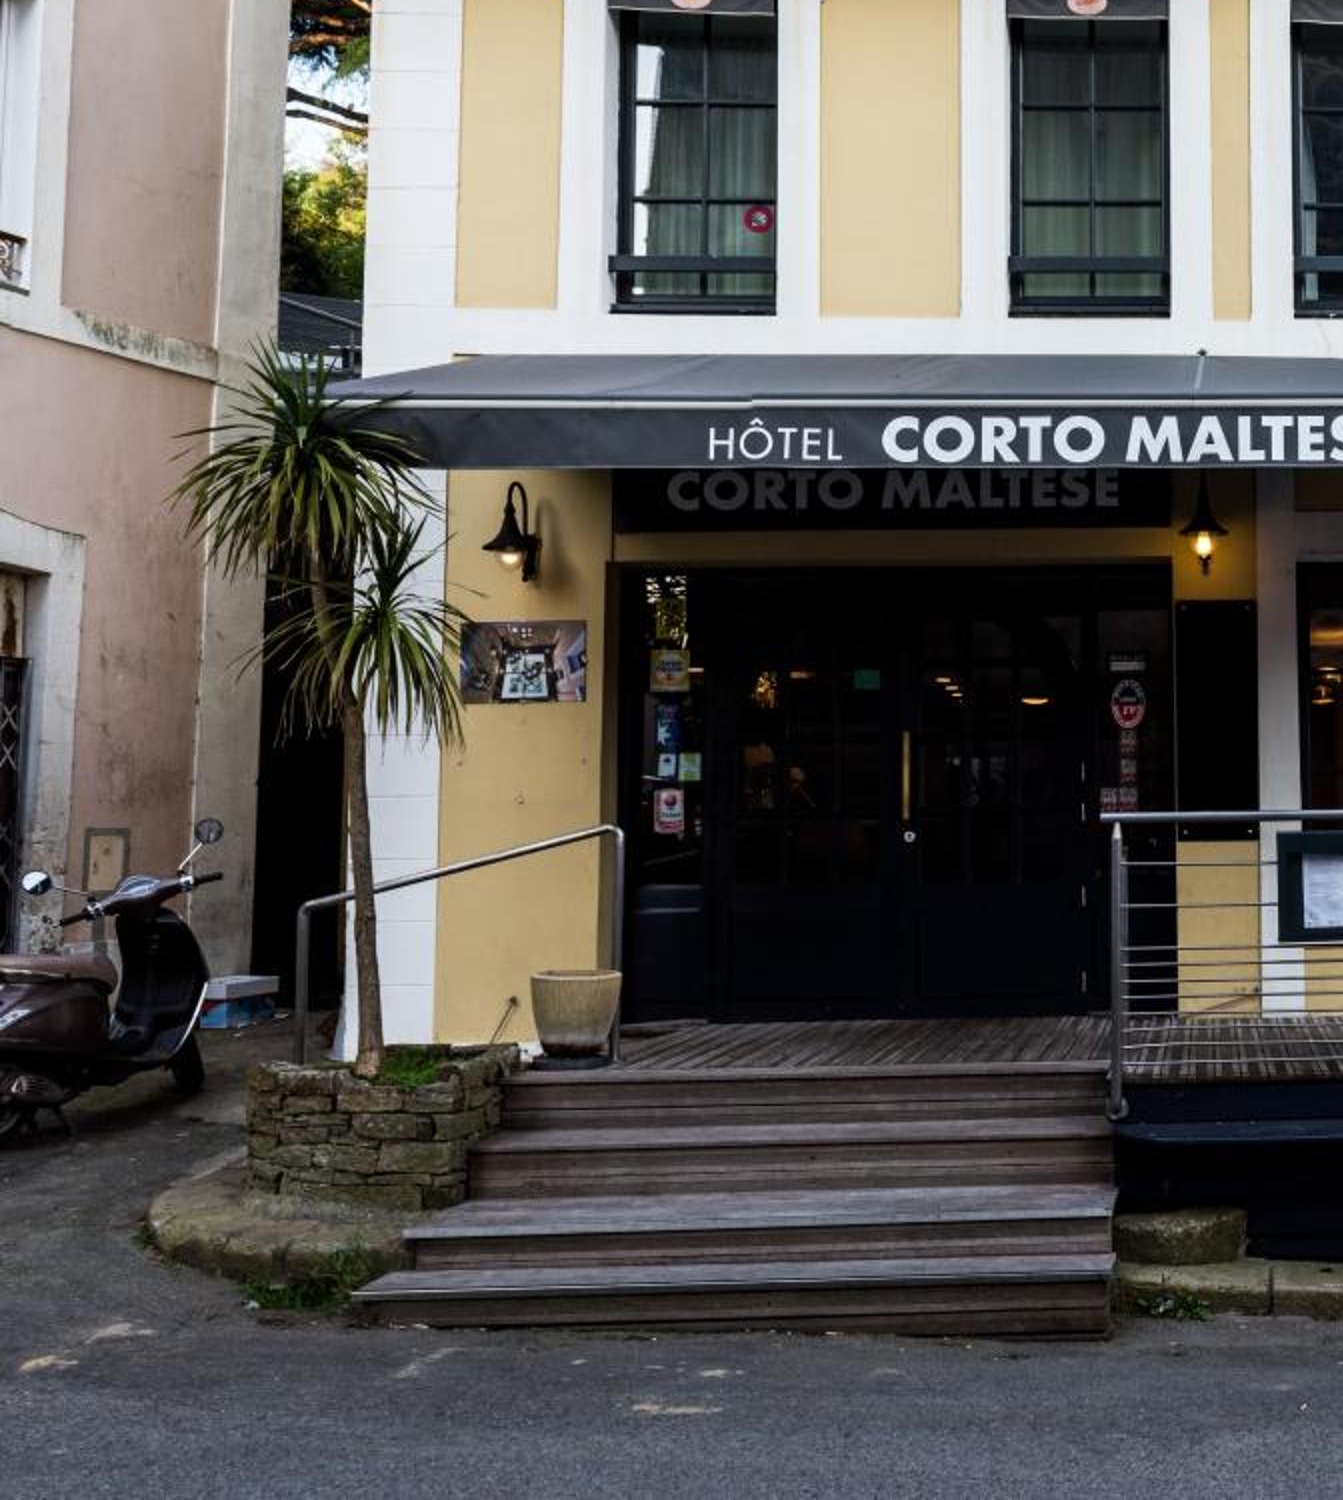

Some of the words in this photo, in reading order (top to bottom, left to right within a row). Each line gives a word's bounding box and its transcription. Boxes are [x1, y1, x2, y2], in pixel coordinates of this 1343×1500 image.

[708, 417, 843, 461] HÔTEL
[881, 415, 1105, 463] CORTO
[667, 470, 863, 511] CORTO
[881, 469, 1119, 509] MALTESE
